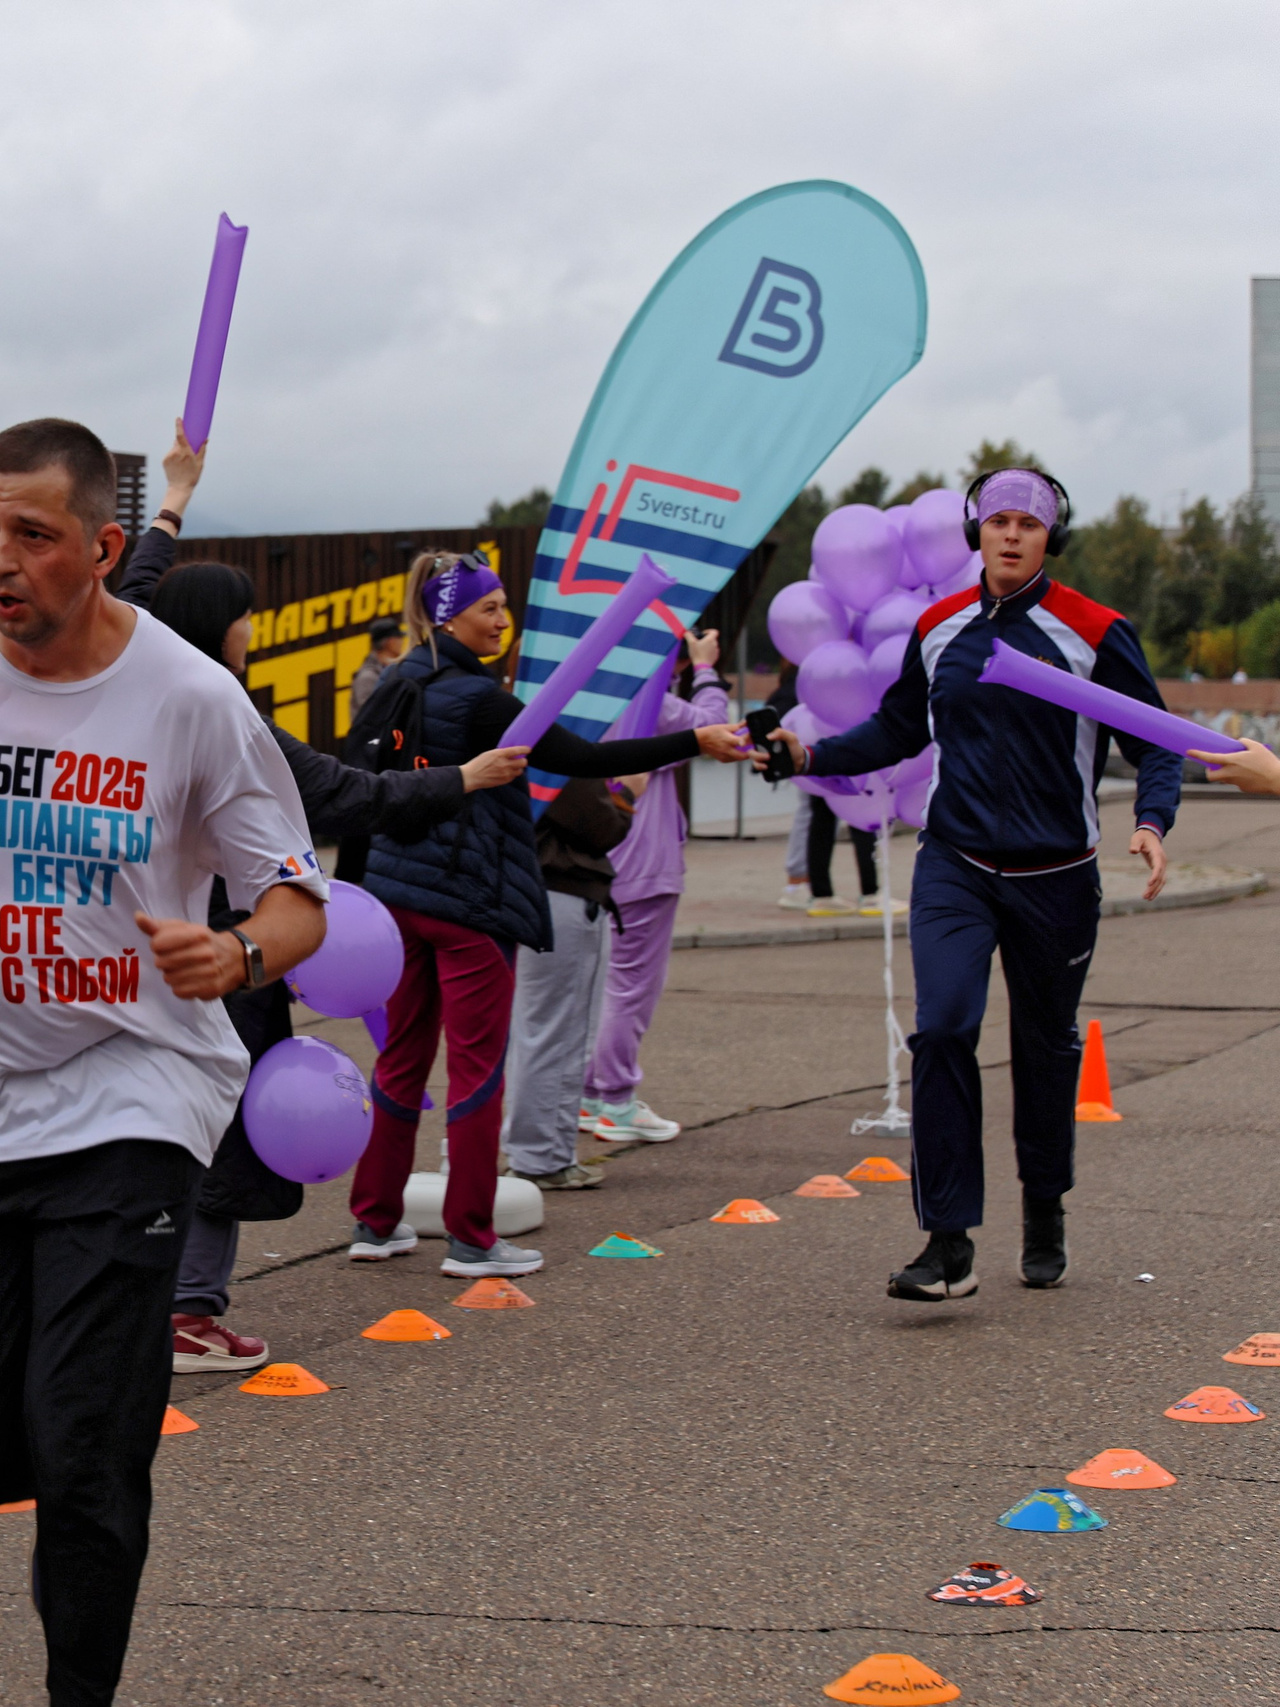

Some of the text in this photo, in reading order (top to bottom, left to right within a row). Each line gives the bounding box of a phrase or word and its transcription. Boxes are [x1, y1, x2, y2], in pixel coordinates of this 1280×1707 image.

[636, 492, 726, 530] 5verst.ru
[12, 853, 120, 906] БЕГУТ
[1, 947, 140, 1004] С ТОБОЙ
